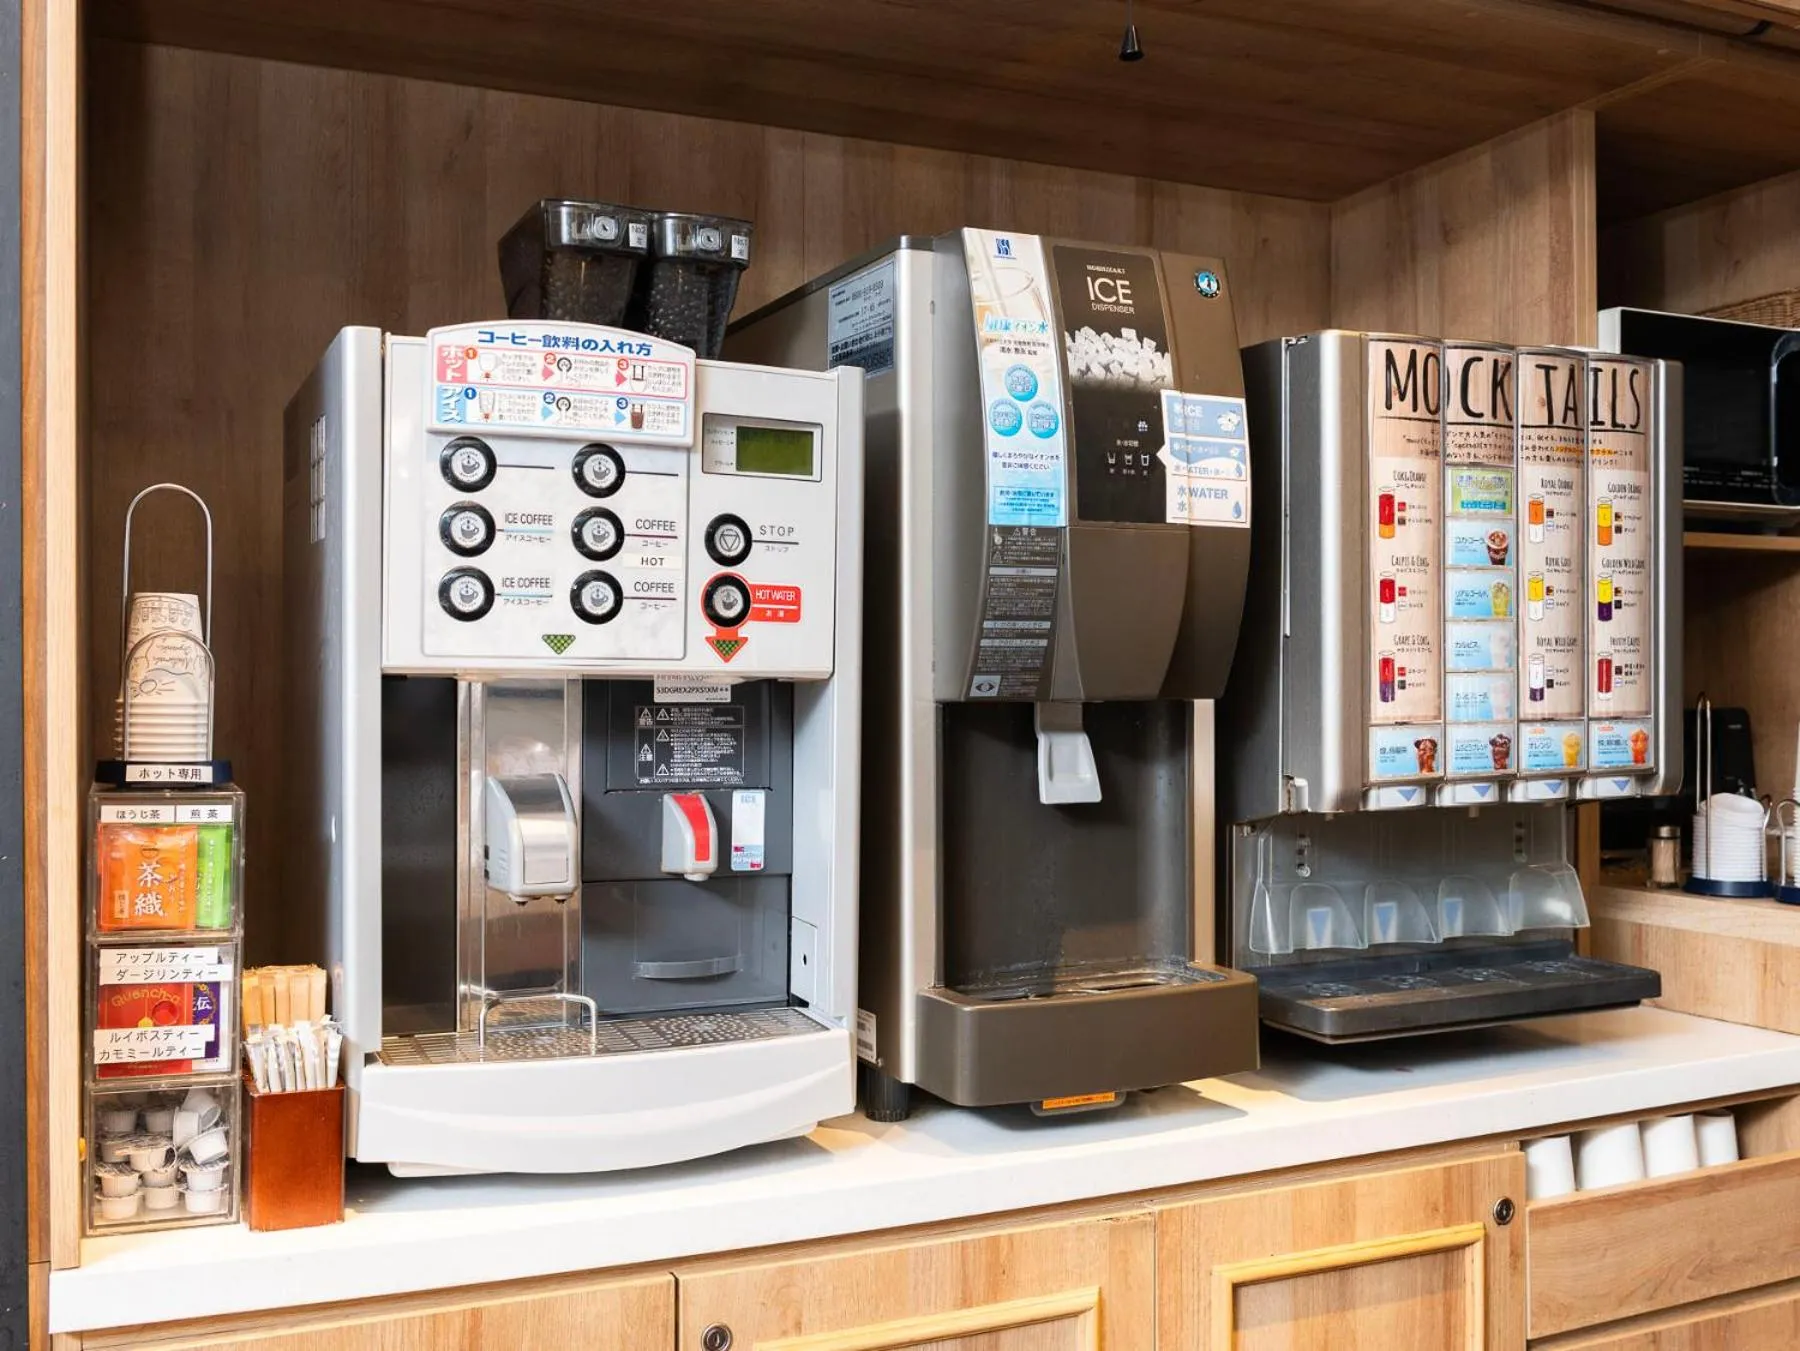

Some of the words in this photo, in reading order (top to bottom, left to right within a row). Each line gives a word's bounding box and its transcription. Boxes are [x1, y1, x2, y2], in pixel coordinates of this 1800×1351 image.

[1086, 276, 1133, 304] ICE
[477, 330, 653, 356] コーヒー飲料の入れ方
[1385, 349, 1513, 421] MOCK
[1535, 363, 1641, 429] TAILS
[1188, 486, 1228, 500] WATER
[505, 512, 518, 524] ICE
[520, 514, 553, 526] COFFEE
[635, 518, 677, 532] COFFEE
[759, 524, 795, 537] STOP
[641, 556, 665, 567] HOT
[502, 577, 515, 589] ICE
[518, 577, 551, 589] COFFEE
[633, 581, 675, 594] COFFEE
[755, 589, 771, 600] HOT
[772, 590, 796, 602] WATER
[139, 769, 202, 780] ホット専用
[116, 810, 160, 820] ほうじ茶
[116, 952, 204, 965] アップルティー
[115, 969, 219, 981] ダージリンティー
[110, 1030, 200, 1043] ルイボスティー
[100, 1047, 203, 1061] カモミールティー
